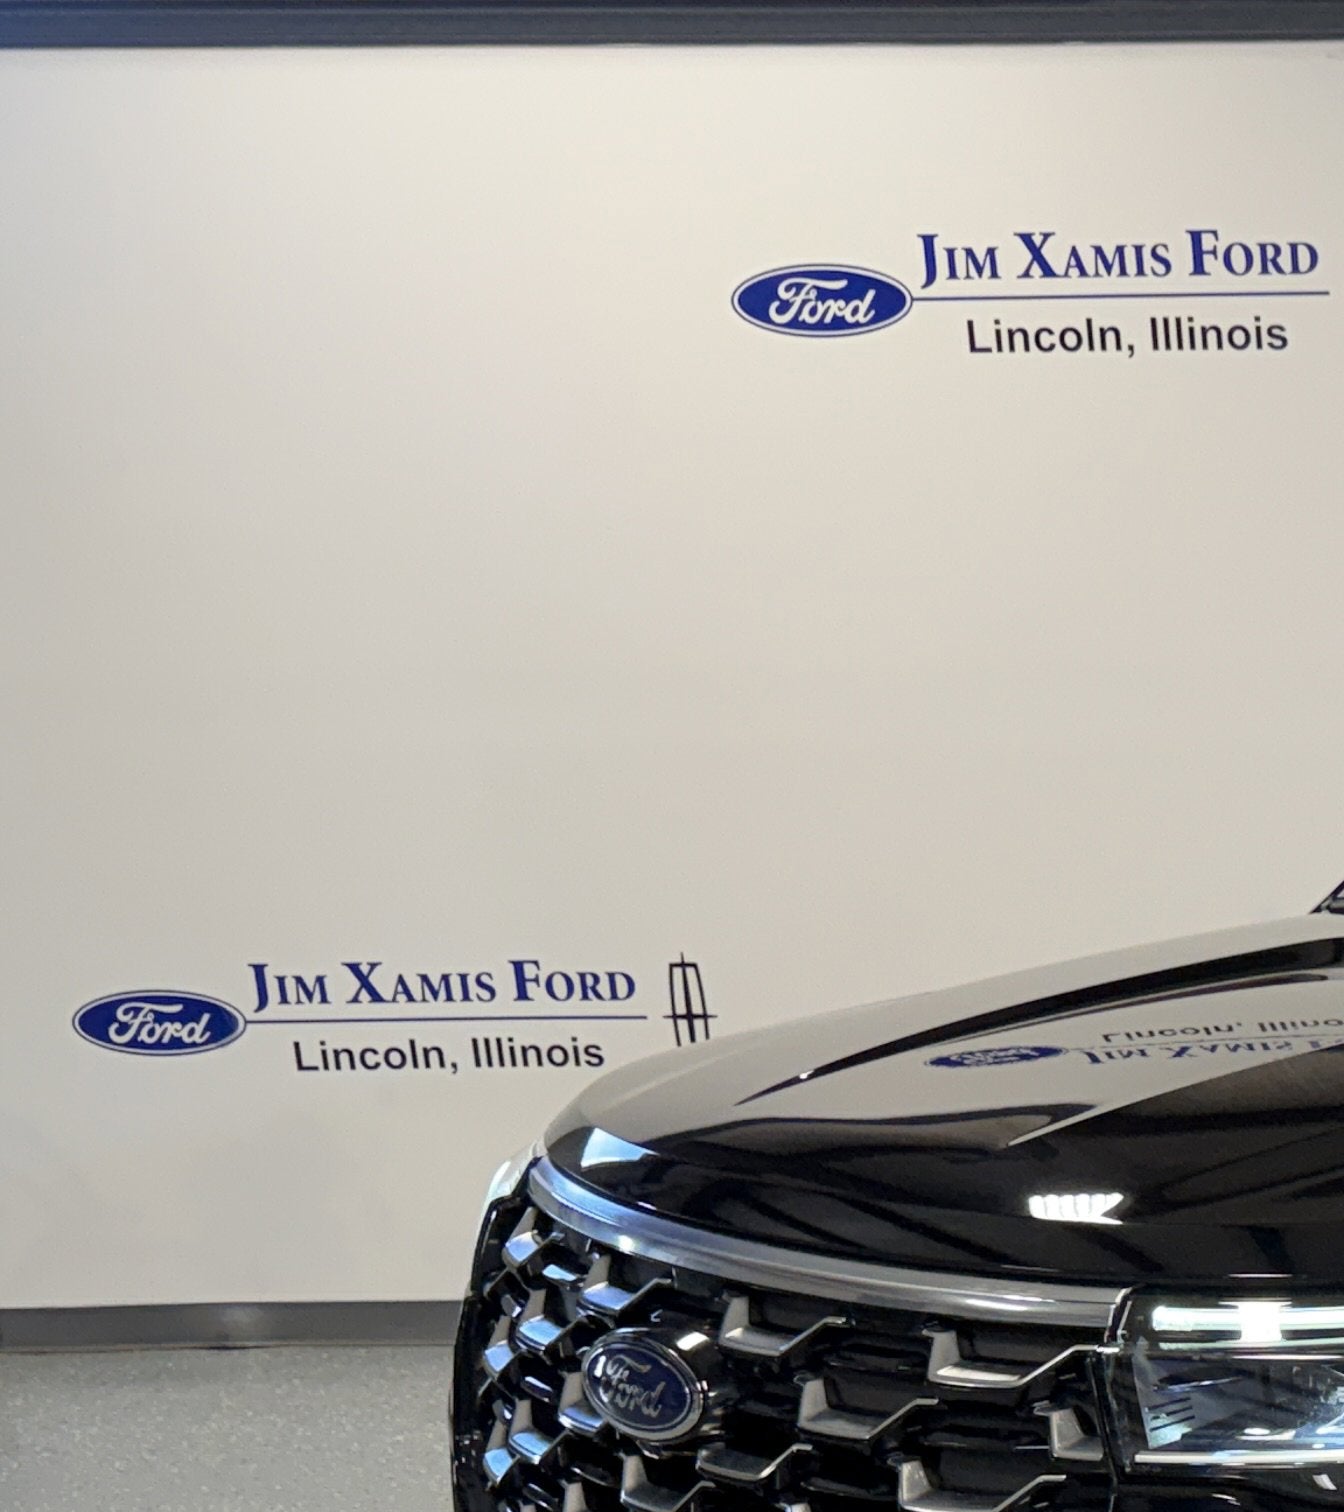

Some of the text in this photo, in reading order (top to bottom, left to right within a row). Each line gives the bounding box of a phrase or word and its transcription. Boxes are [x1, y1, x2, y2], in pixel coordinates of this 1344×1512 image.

[768, 277, 875, 325] Ford
[966, 315, 1289, 358] Lincoln, Illinois
[108, 1003, 212, 1045] Ford
[293, 1036, 605, 1075] Lincoln, Illinois
[601, 1354, 666, 1418] Ford
